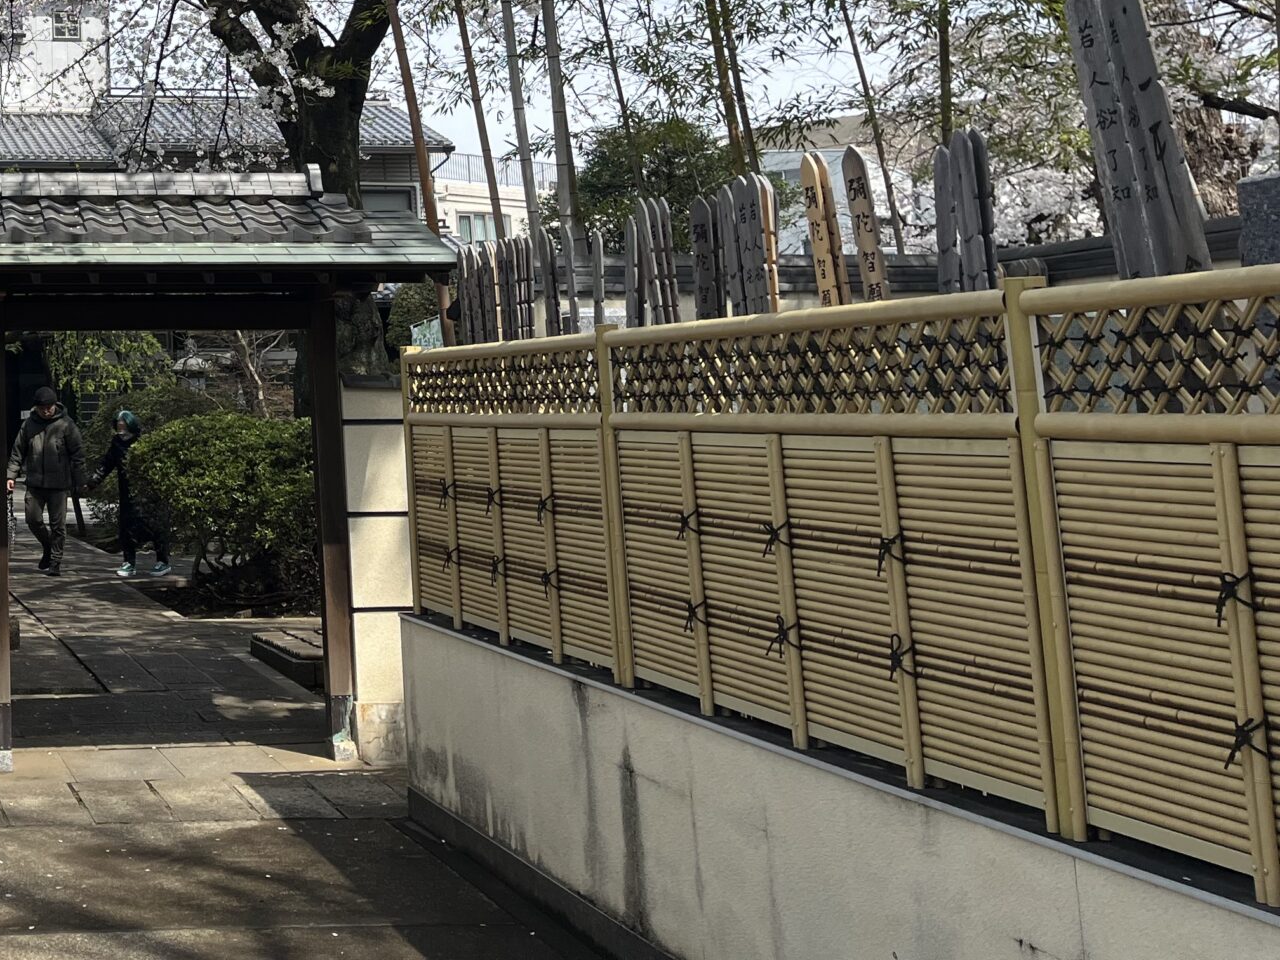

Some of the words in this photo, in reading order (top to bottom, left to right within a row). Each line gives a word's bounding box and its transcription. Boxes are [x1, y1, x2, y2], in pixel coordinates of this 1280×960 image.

[1078, 19, 1141, 279] 若人欲了知
